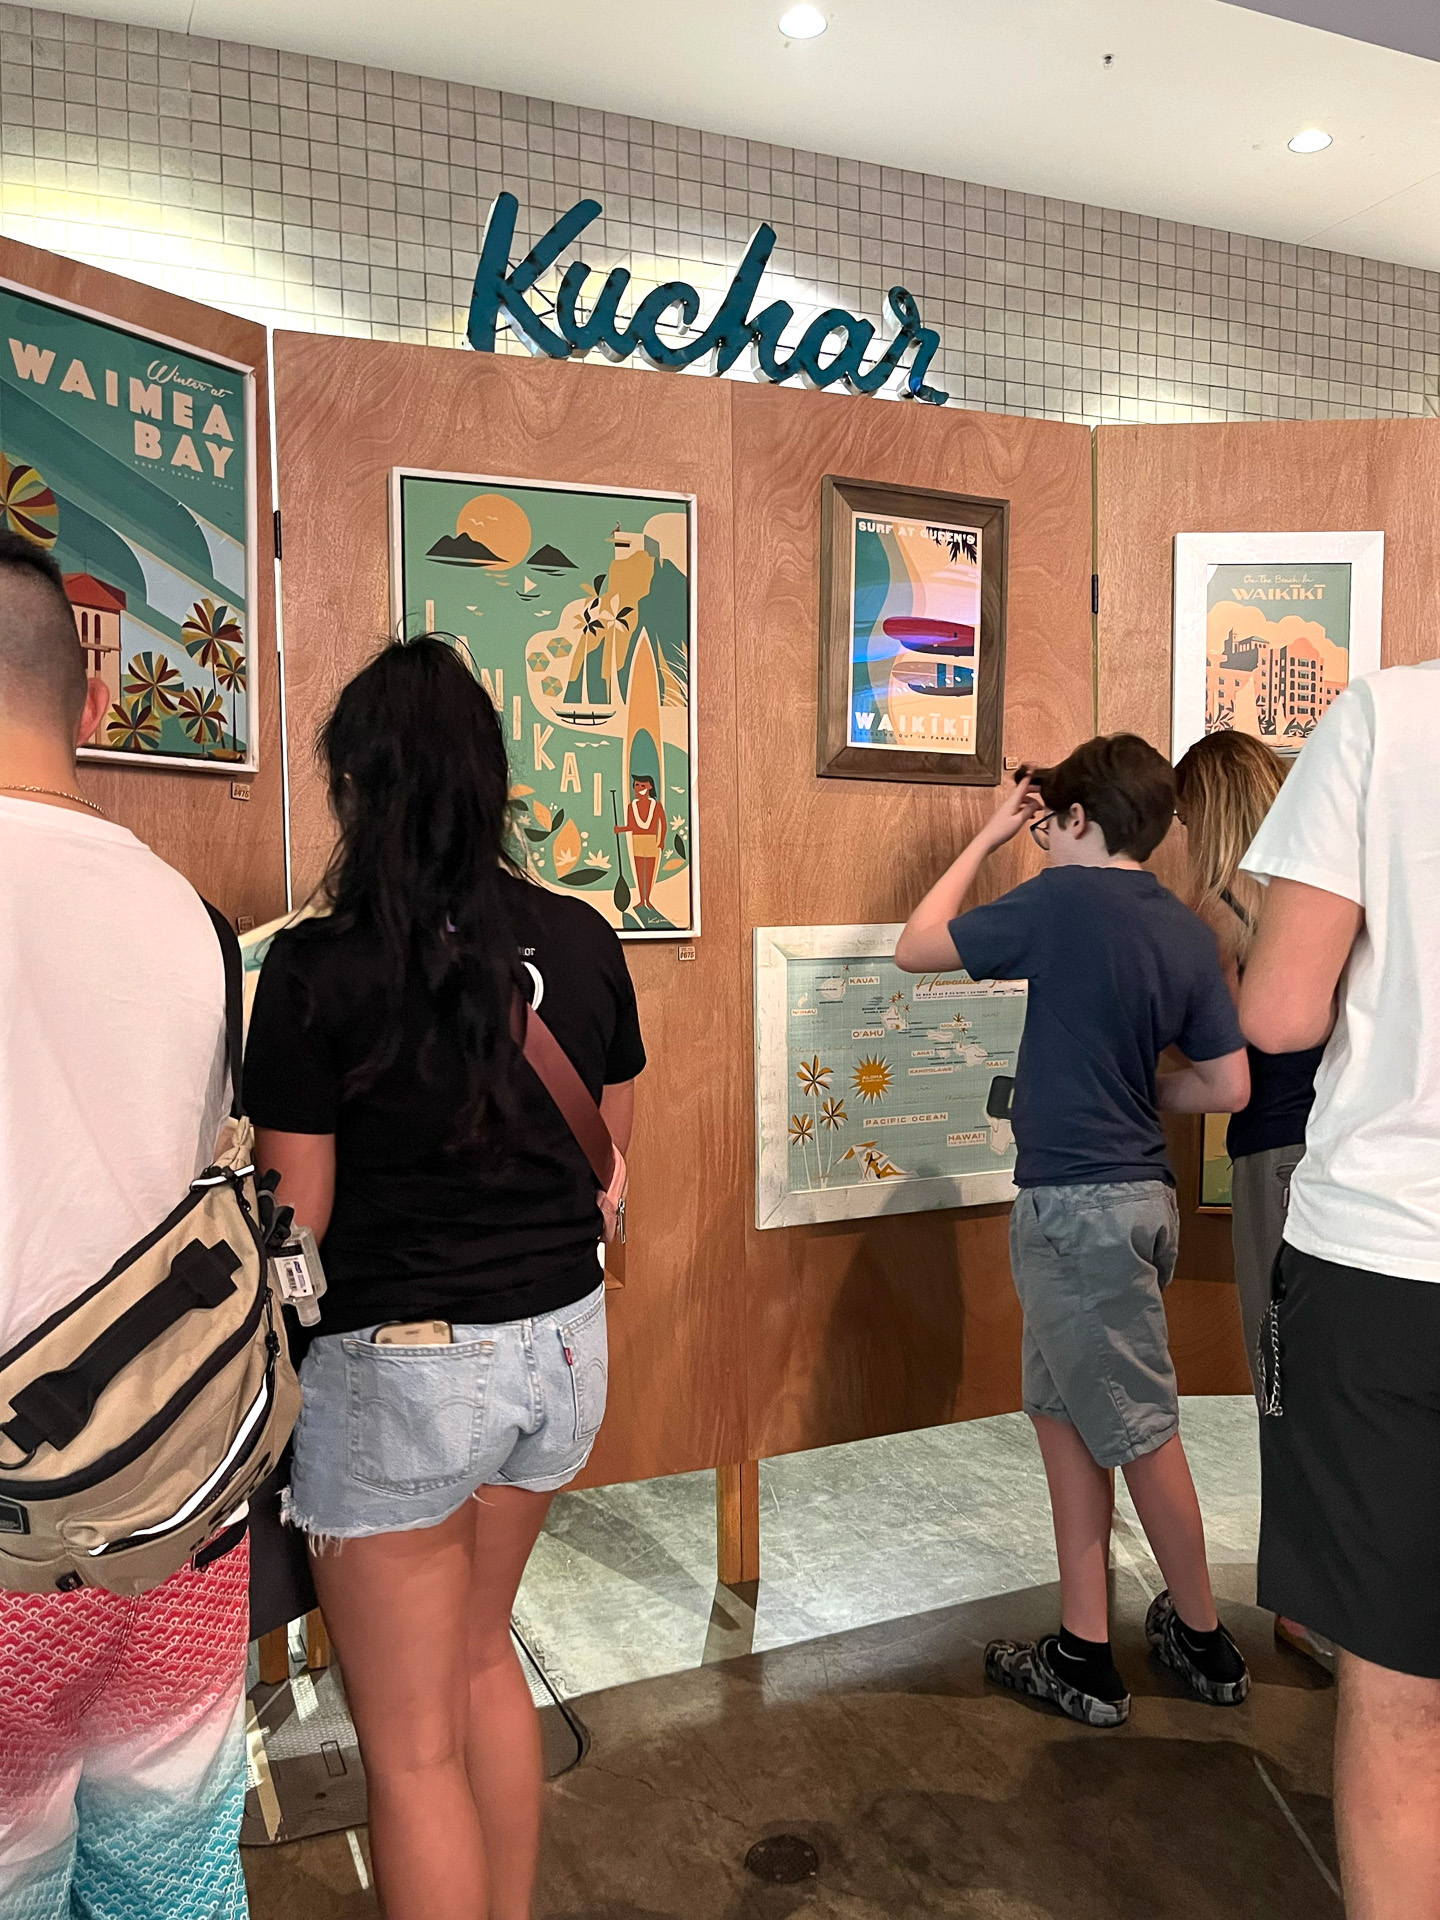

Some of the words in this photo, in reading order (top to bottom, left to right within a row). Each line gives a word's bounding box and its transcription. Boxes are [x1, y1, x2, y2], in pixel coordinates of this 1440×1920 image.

[468, 192, 949, 405] Kuchar
[8, 338, 234, 442] WAIMEA
[147, 360, 213, 391] Winter
[211, 388, 233, 398] at
[134, 420, 234, 479] BAY
[858, 521, 894, 535] SURF
[898, 526, 916, 537] AT
[920, 528, 976, 545] QUEEN'S
[1244, 574, 1259, 583] On
[852, 1030, 883, 1038] O'AHU
[865, 1116, 907, 1126] PACIFIC
[911, 1113, 947, 1122] OCEAN
